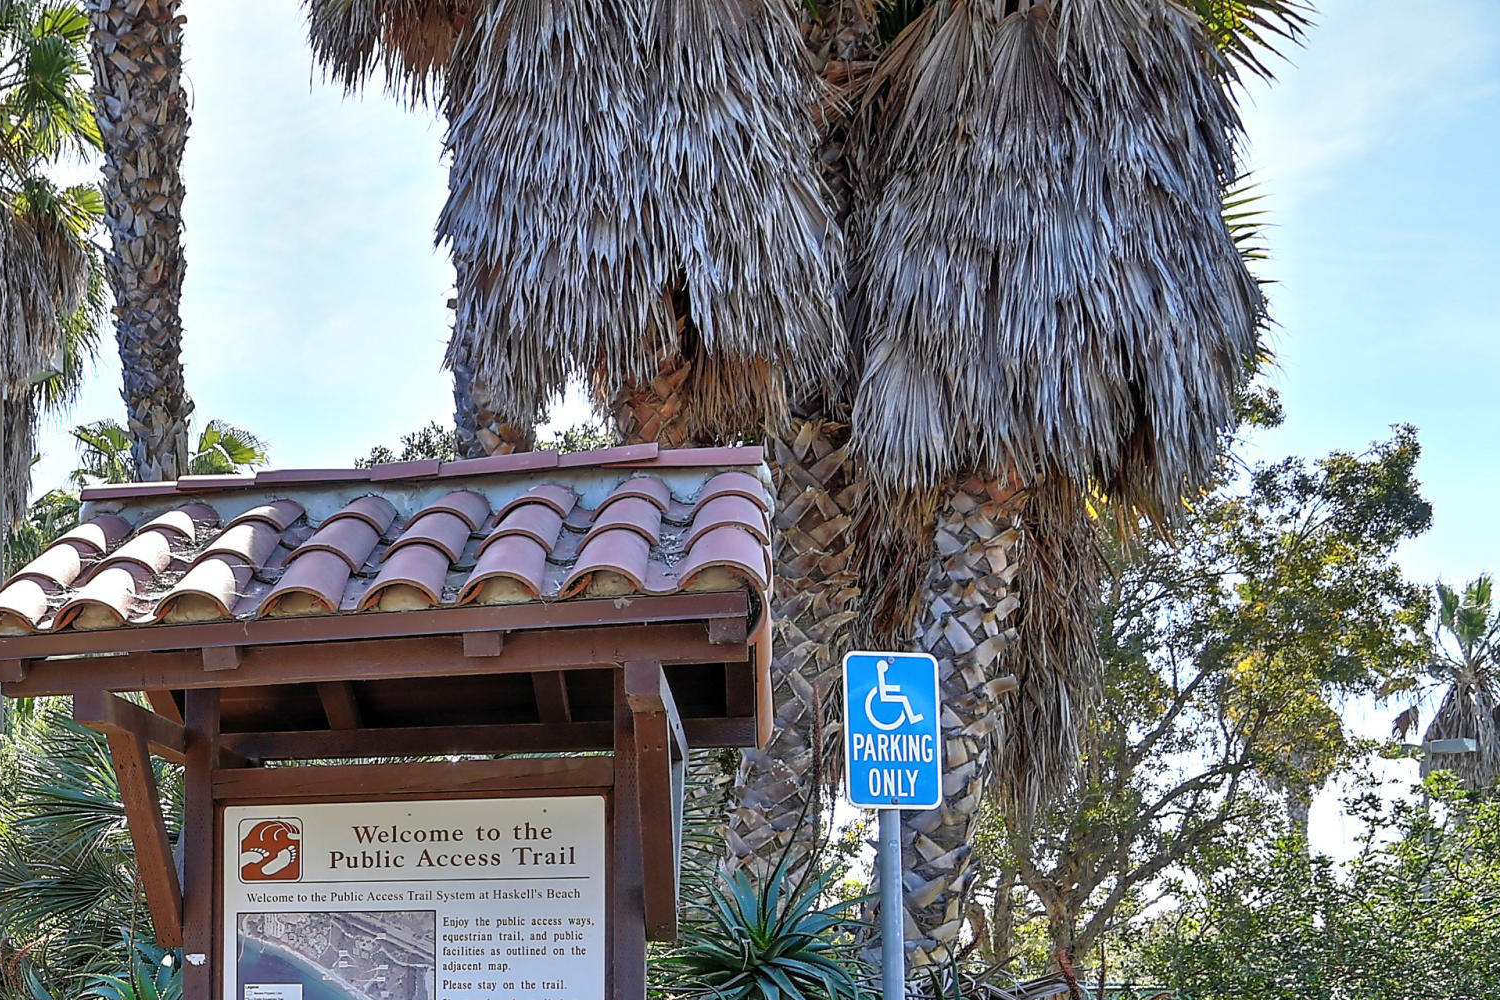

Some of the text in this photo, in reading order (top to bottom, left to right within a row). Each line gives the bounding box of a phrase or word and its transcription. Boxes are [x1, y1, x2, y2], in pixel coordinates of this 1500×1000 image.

[853, 733, 933, 763] PARKING
[868, 768, 919, 797] ONLY
[352, 822, 553, 844] Welcome to the
[329, 846, 576, 869] Public Access Trail
[247, 888, 581, 903] Welcome to the Public Access Trail System at Haskell's Beach
[443, 917, 469, 928] Enjoy
[475, 917, 490, 927] the
[496, 916, 525, 928] public
[531, 917, 562, 926] access
[442, 931, 583, 943] equestrian trail, and public
[442, 946, 586, 956] facilities as outlined on the
[442, 962, 511, 973] adjacent map.
[443, 980, 567, 991] Please stay on the trail.
